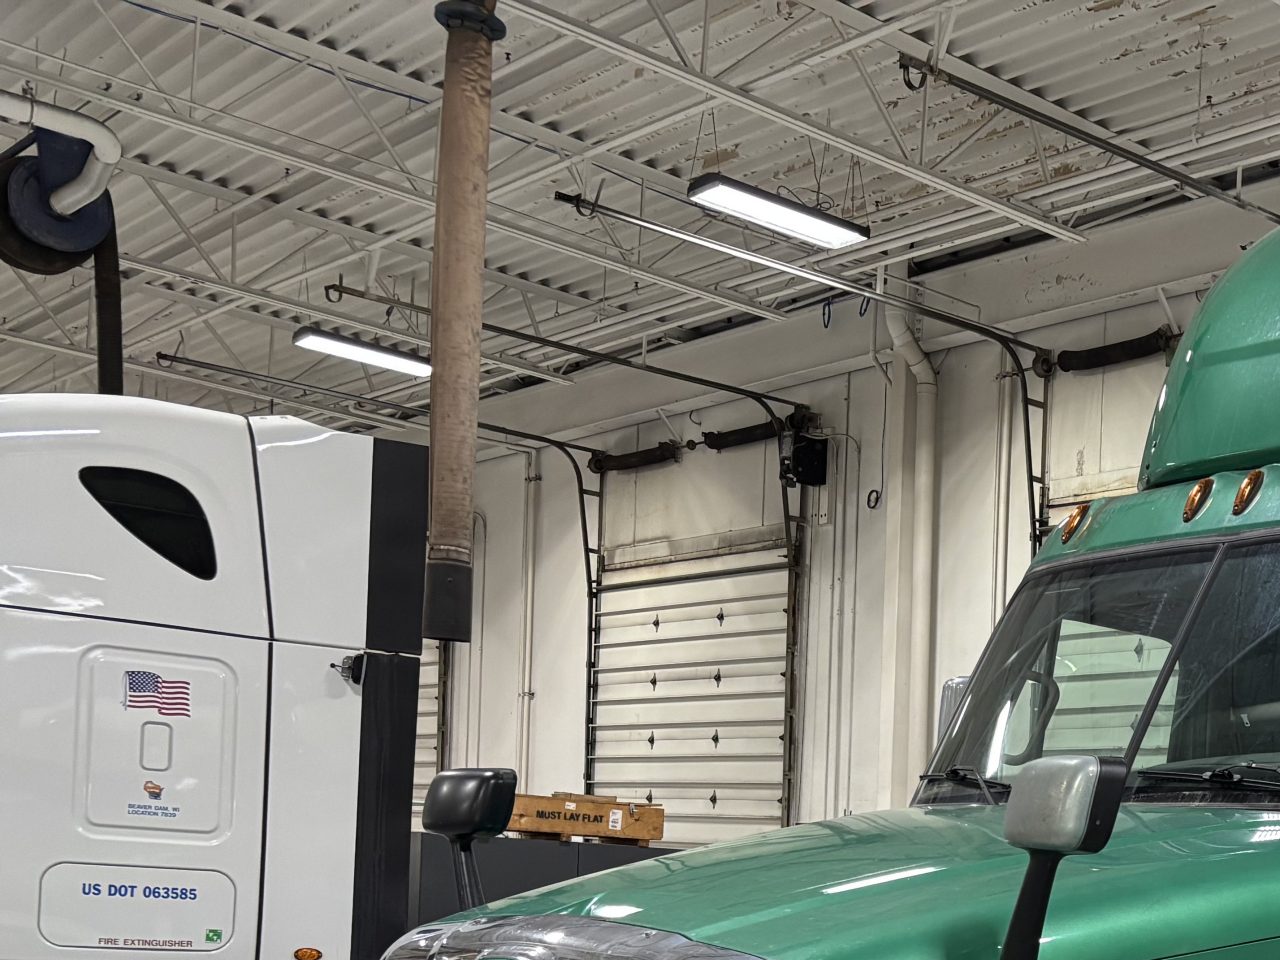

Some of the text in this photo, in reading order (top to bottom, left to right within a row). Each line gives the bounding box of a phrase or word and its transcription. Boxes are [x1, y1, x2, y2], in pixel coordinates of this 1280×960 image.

[535, 810, 562, 820] MUST
[564, 812, 580, 822] LAY
[582, 814, 604, 824] FLAT
[82, 882, 198, 901] US DOT 063585
[98, 937, 193, 948] FIRE EXTINGUISHER
